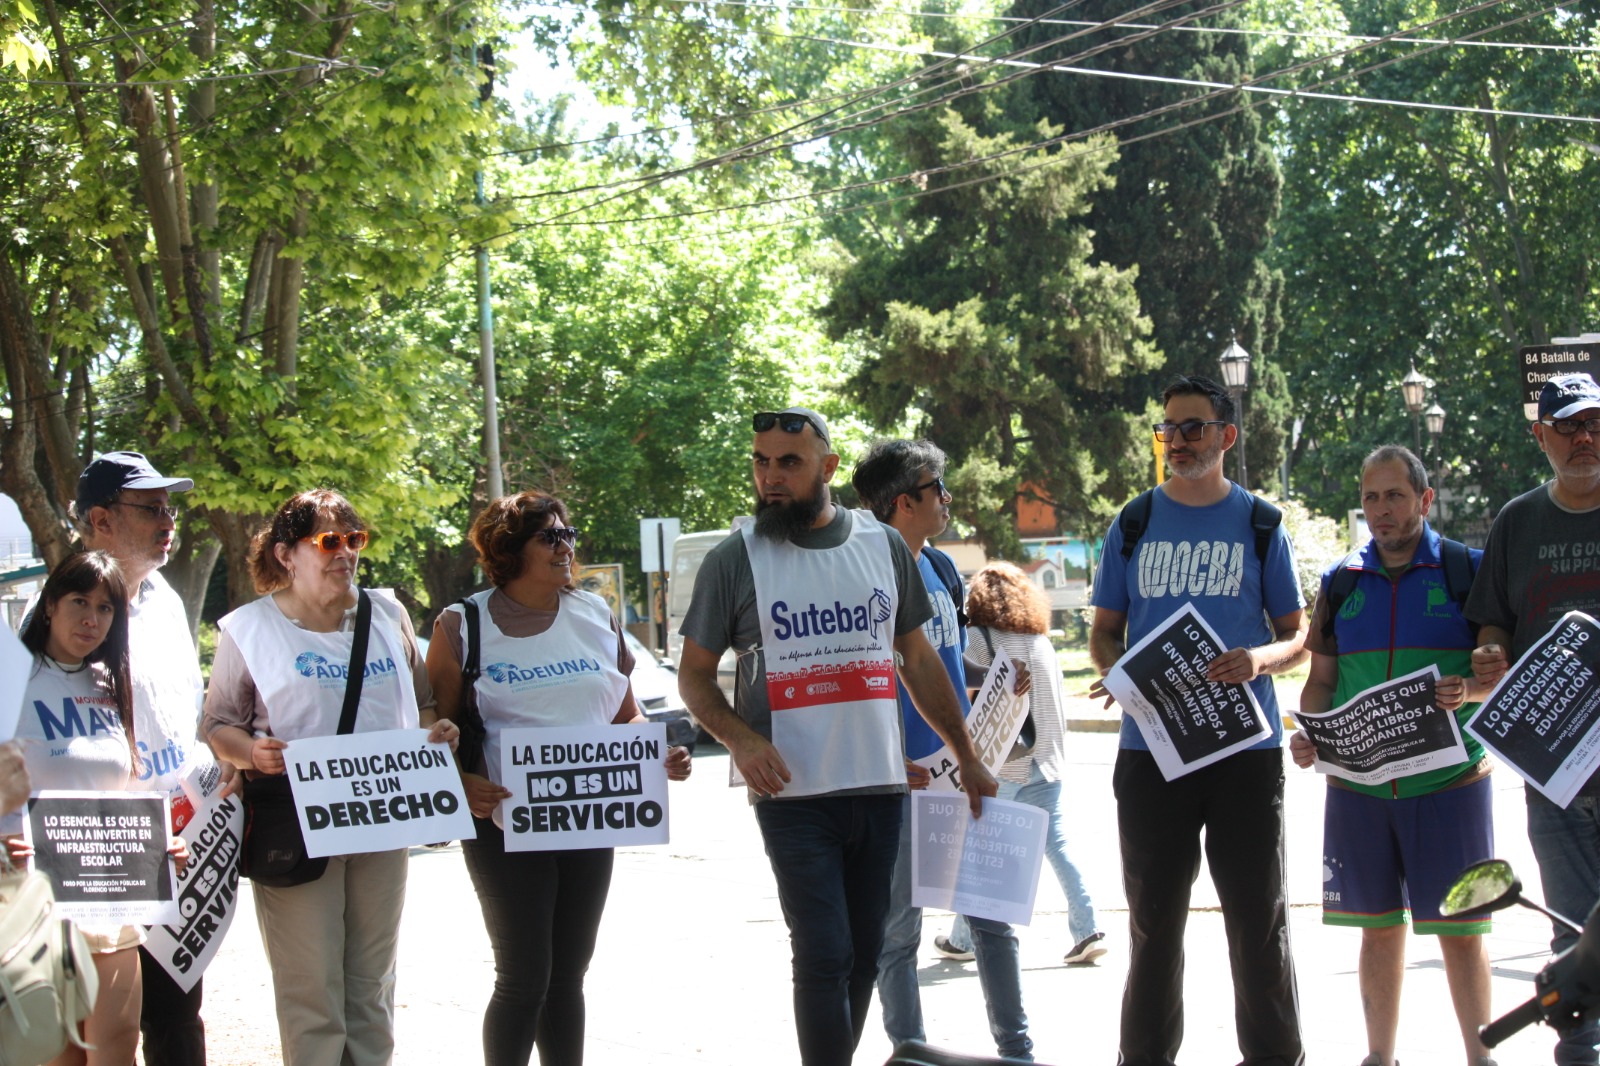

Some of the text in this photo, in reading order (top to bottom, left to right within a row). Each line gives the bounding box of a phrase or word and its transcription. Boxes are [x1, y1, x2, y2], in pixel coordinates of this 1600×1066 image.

[1525, 350, 1590, 364] 84 Batalla de
[1138, 540, 1244, 599] UDOCBA
[1538, 543, 1568, 559] DRY
[771, 600, 869, 641] Suteba
[789, 650, 813, 663] defensa
[814, 647, 823, 657] de
[824, 646, 833, 655] la
[834, 645, 866, 655] educación
[1162, 641, 1202, 688] ENTREGAR
[1195, 687, 1223, 729] LIBROS
[1216, 729, 1228, 740] A
[1183, 624, 1254, 729] LO ES QUE
[1483, 709, 1501, 729] LO
[1499, 656, 1546, 711] ESENCIAL
[1542, 646, 1558, 660] ES
[1555, 621, 1581, 647] QUE
[1495, 718, 1514, 738] LA
[1510, 648, 1574, 719] MOTOSIERRA
[1569, 630, 1590, 651] NO
[1525, 657, 1583, 726] SE META EN
[929, 661, 1010, 779] LA UCACIÓN
[1216, 700, 1228, 710] A
[1305, 681, 1427, 730] LO ESENCIAL ES QUE
[1334, 701, 1404, 738] VUELVAN A
[1534, 666, 1594, 737] EDUCACIÓN
[982, 696, 1024, 769] VICIO
[1314, 704, 1436, 748] ENTREGAR LIBROS A
[1336, 721, 1419, 757] ESTUDIANTES
[1548, 740, 1561, 753] FORO
[1559, 730, 1569, 741] POR
[1566, 723, 1574, 731] LA
[1571, 697, 1593, 725] EDUCACIÓN
[1567, 712, 1590, 738] FLORENCIO
[295, 745, 449, 782] LA EDUCACIÓN
[512, 736, 660, 766] LA EDUCACIÓN
[1387, 748, 1406, 757] VARELA
[351, 776, 402, 797] ES UN
[530, 769, 638, 799] NO ES UN
[44, 815, 152, 829] LO ESENCIAL ES QUE SE
[305, 790, 459, 831] DERECHO
[511, 800, 664, 834] SERVICIO
[46, 828, 153, 841] VUELVA A INVERTIR EN
[56, 841, 146, 854] INFRAESTRUCTURA
[80, 855, 124, 867] ESCOLAR
[194, 867, 219, 895] ES
[213, 834, 237, 868] UN
[92, 879, 119, 887] EDUCACIÓN
[119, 879, 140, 887] PÚBLICA
